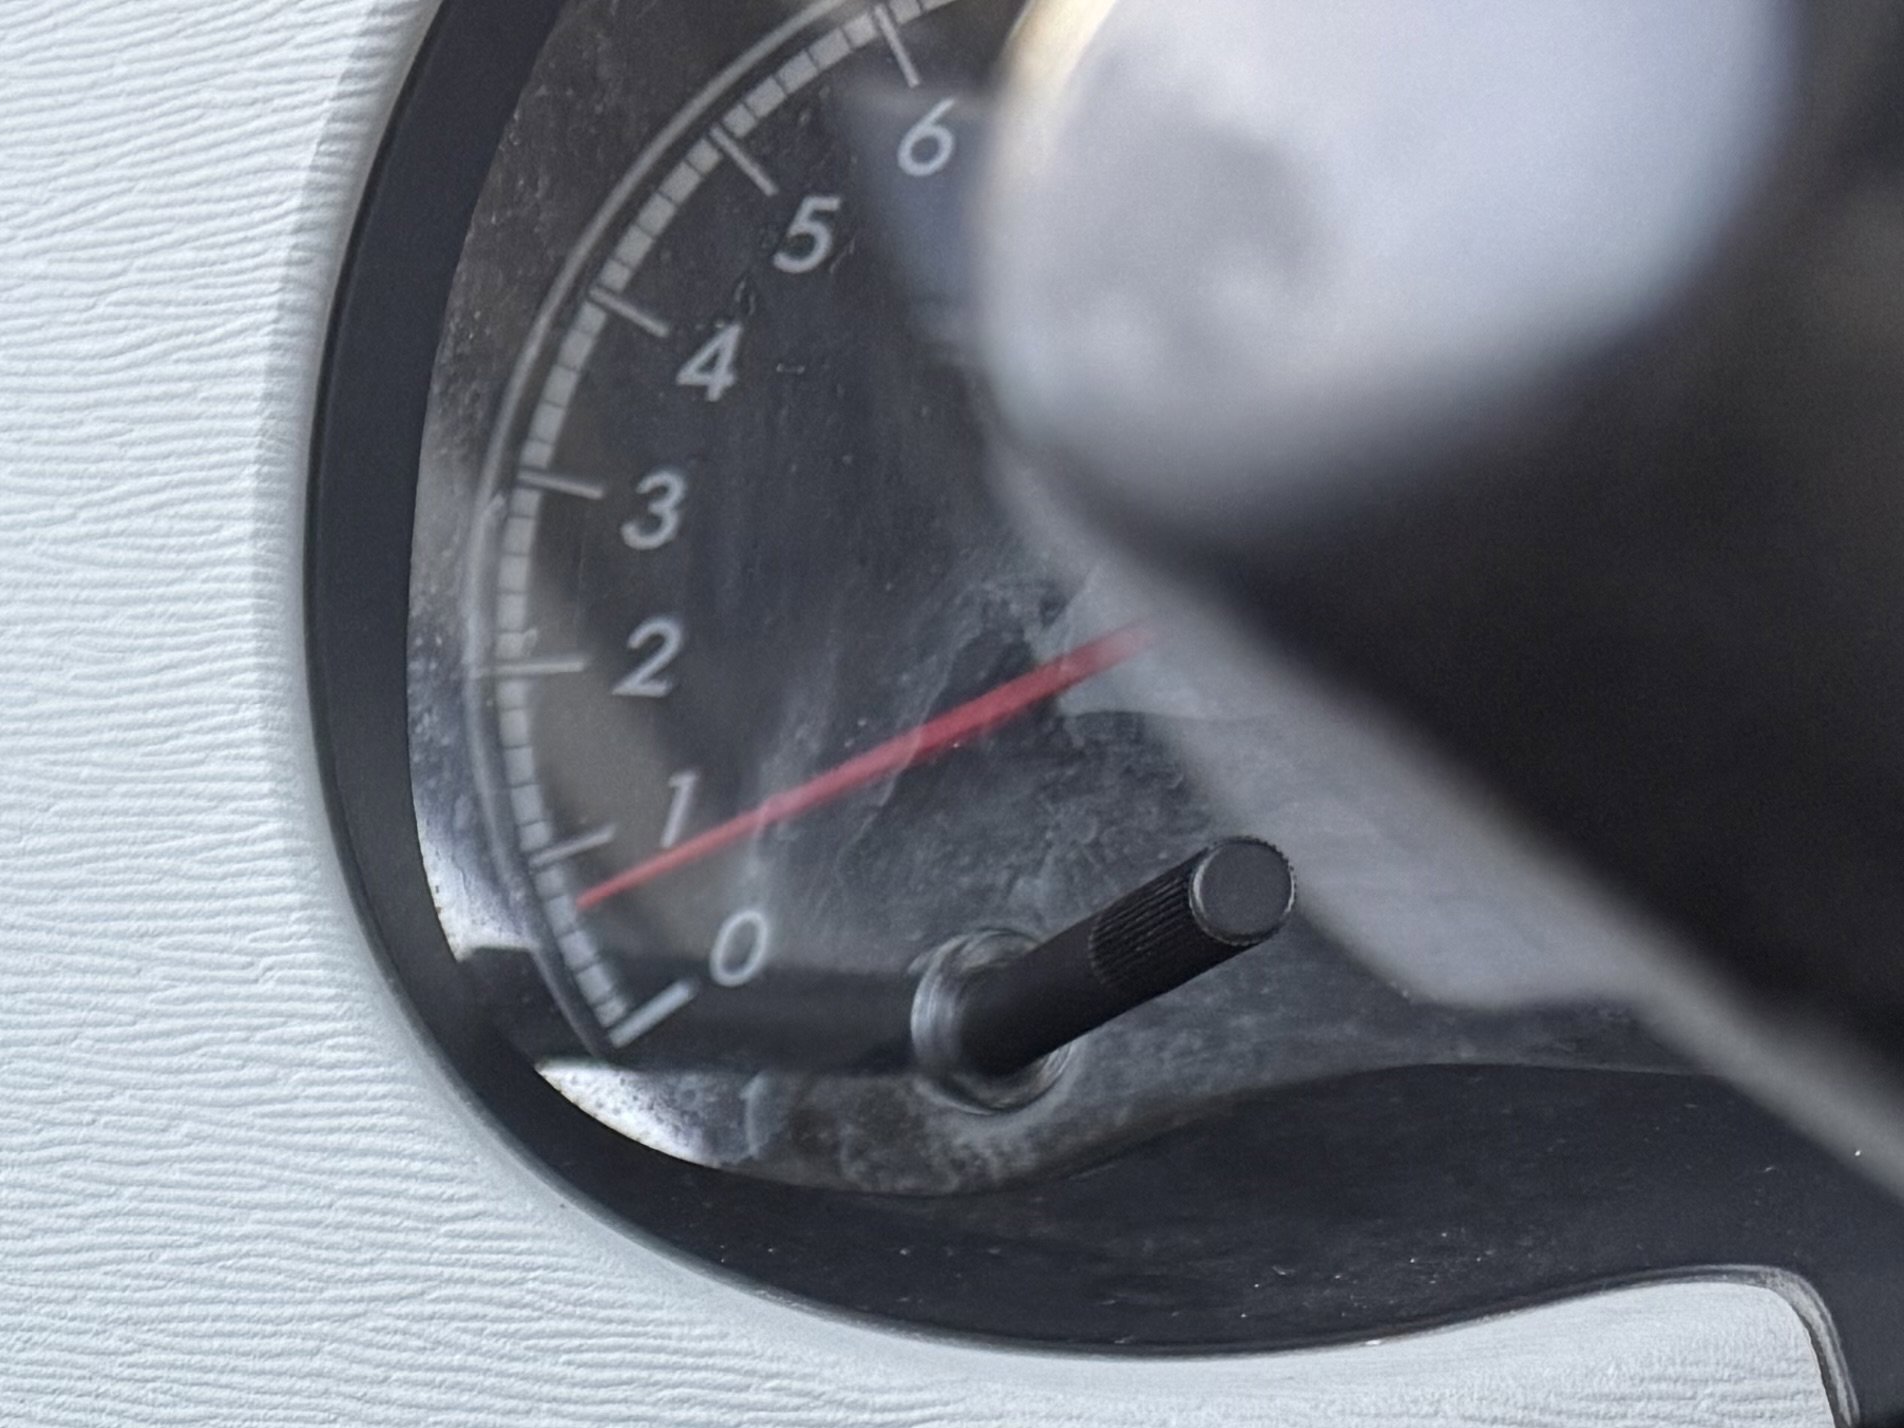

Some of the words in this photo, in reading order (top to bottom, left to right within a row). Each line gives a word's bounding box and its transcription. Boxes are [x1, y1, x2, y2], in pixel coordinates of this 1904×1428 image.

[896, 98, 955, 176] 6
[773, 196, 840, 273] 5
[676, 323, 741, 401] 4
[621, 470, 687, 550] 3
[612, 616, 682, 697] 2
[661, 769, 696, 849] 1
[709, 910, 769, 987] 0
